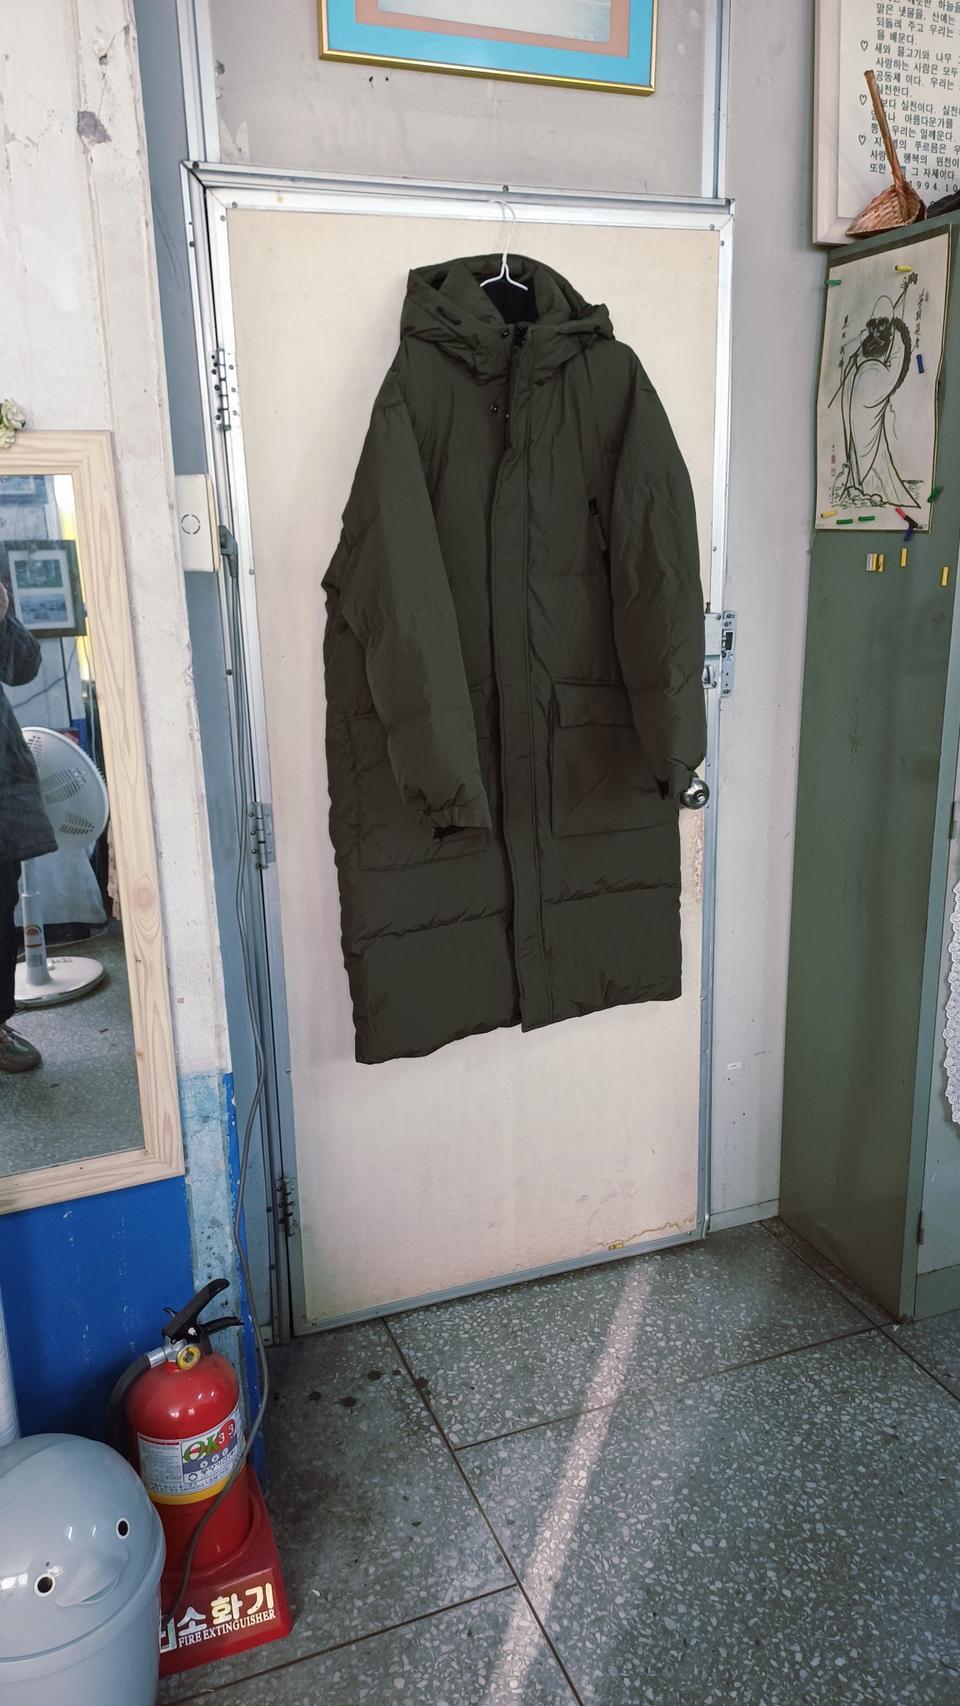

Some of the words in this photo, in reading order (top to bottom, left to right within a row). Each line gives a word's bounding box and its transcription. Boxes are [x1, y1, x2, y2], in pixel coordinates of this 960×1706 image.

[908, 20, 923, 32] 주고
[930, 24, 954, 38] 우리는
[897, 46, 929, 60] 물고기와
[936, 52, 952, 63] 나무
[876, 57, 909, 71] 사랑하는
[914, 62, 938, 75] 사람은
[931, 77, 955, 90] 우리는
[892, 126, 917, 138] 우리는
[904, 153, 928, 165] 행복의
[870, 163, 886, 175] 또한
[911, 168, 919, 176] 그
[178, 1631, 202, 1647] FIRE
[203, 1609, 276, 1640] EXTINGUISHER
